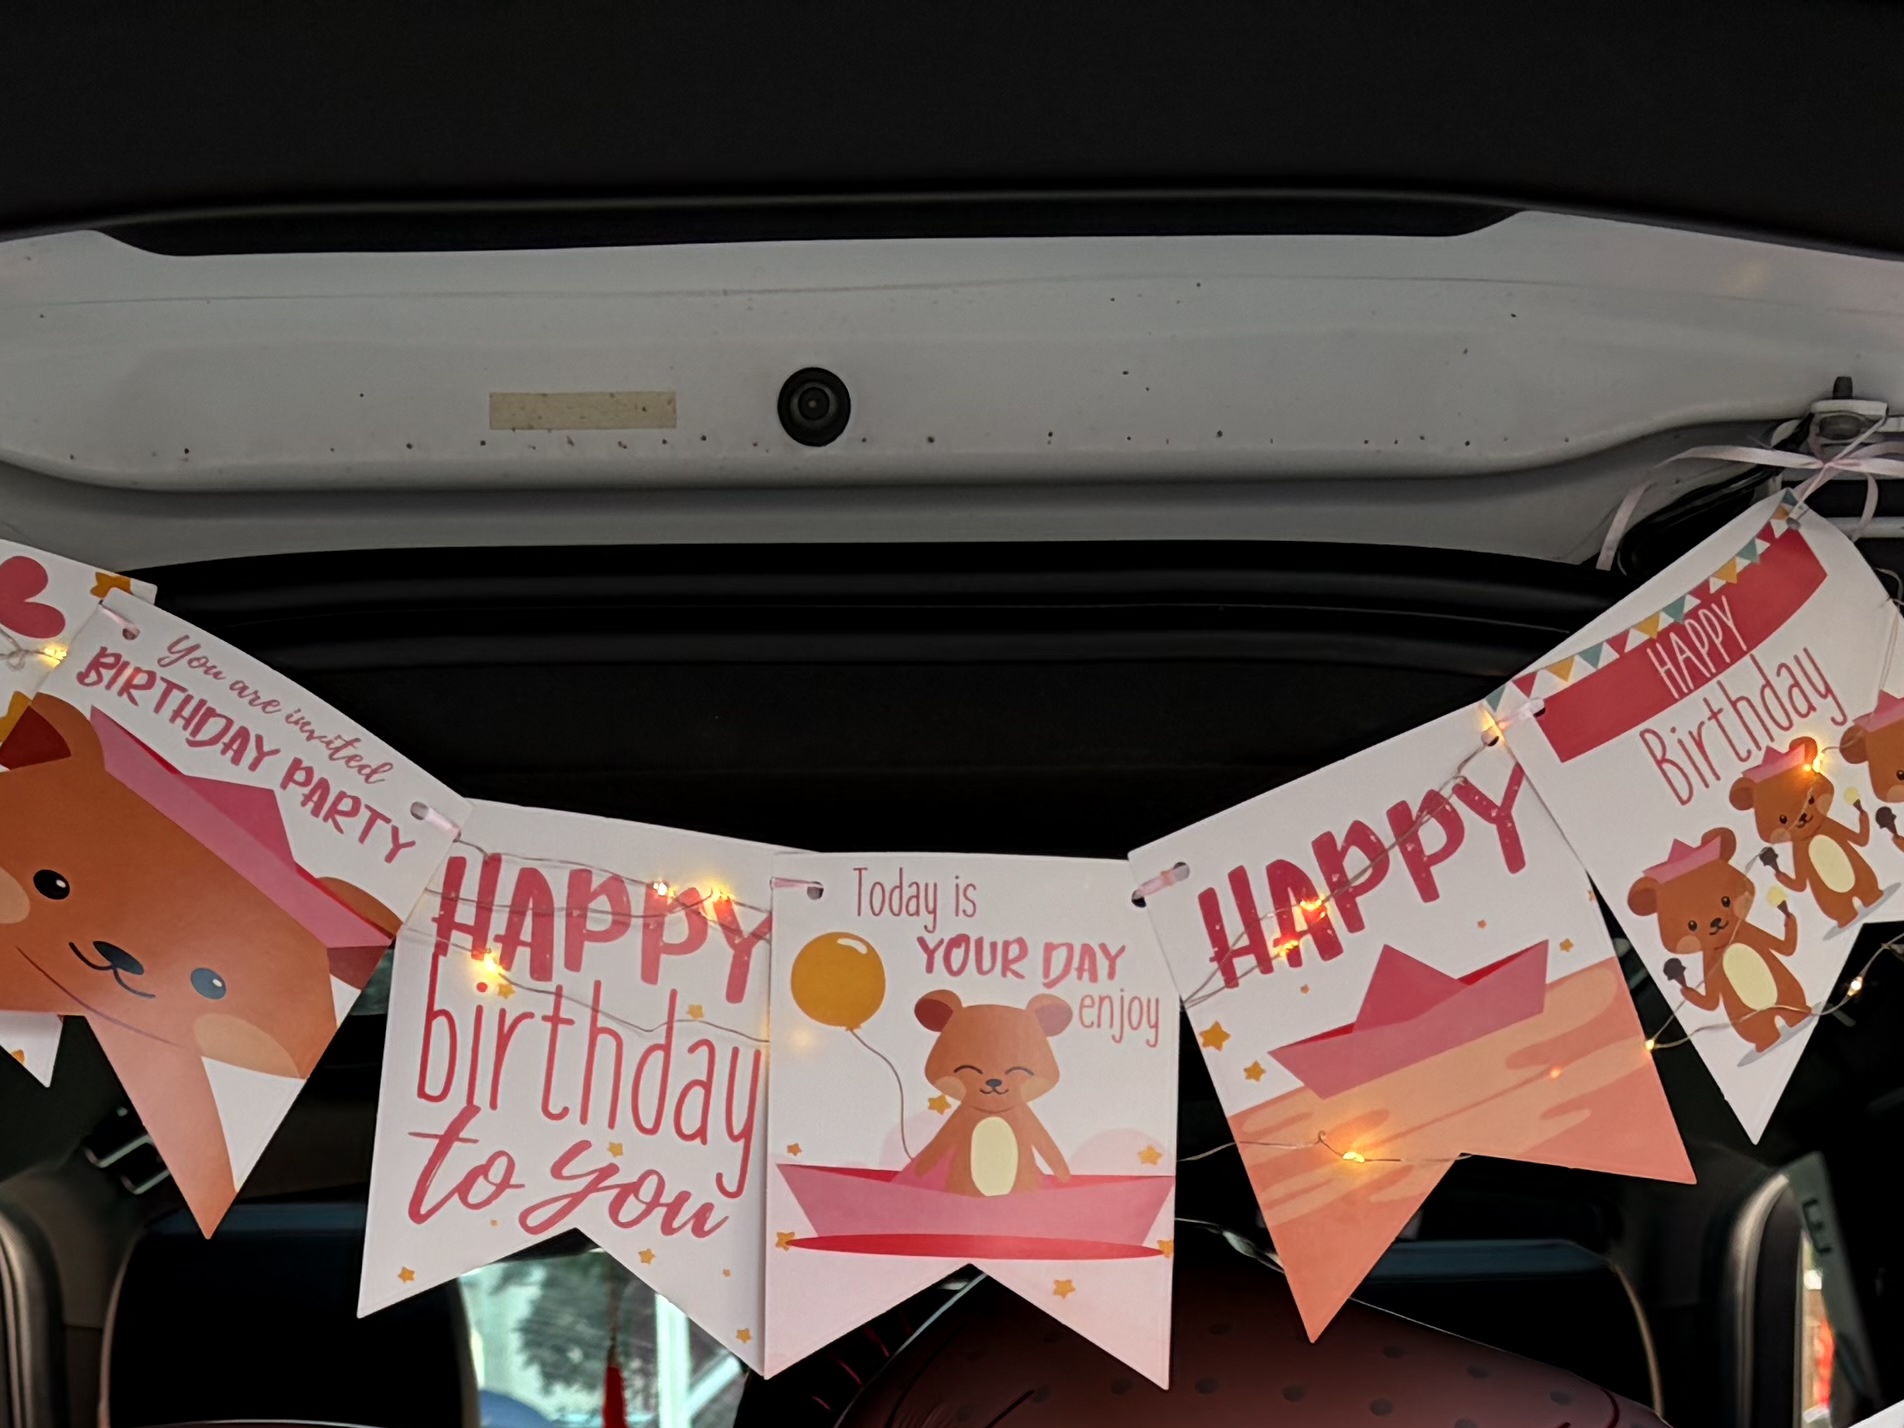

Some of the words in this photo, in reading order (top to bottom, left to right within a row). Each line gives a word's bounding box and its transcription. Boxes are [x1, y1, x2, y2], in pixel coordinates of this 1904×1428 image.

[158, 635, 226, 681] You
[230, 680, 281, 715] are
[286, 708, 394, 785] invited
[1646, 595, 1747, 699] HAPPY
[76, 646, 281, 772] BIRTHDAY
[280, 757, 416, 864] PARTY
[1639, 647, 1847, 806] Birthday
[432, 853, 772, 1004] HAPPY
[853, 867, 938, 933] Today
[954, 875, 977, 918] is
[1198, 761, 1526, 988] HAPPY
[916, 933, 1028, 979] YOUR
[1042, 941, 1126, 989] DAY
[1078, 987, 1160, 1048] enjoy
[417, 951, 762, 1199] birthday
[408, 1104, 525, 1224] to
[518, 1139, 729, 1238] you
